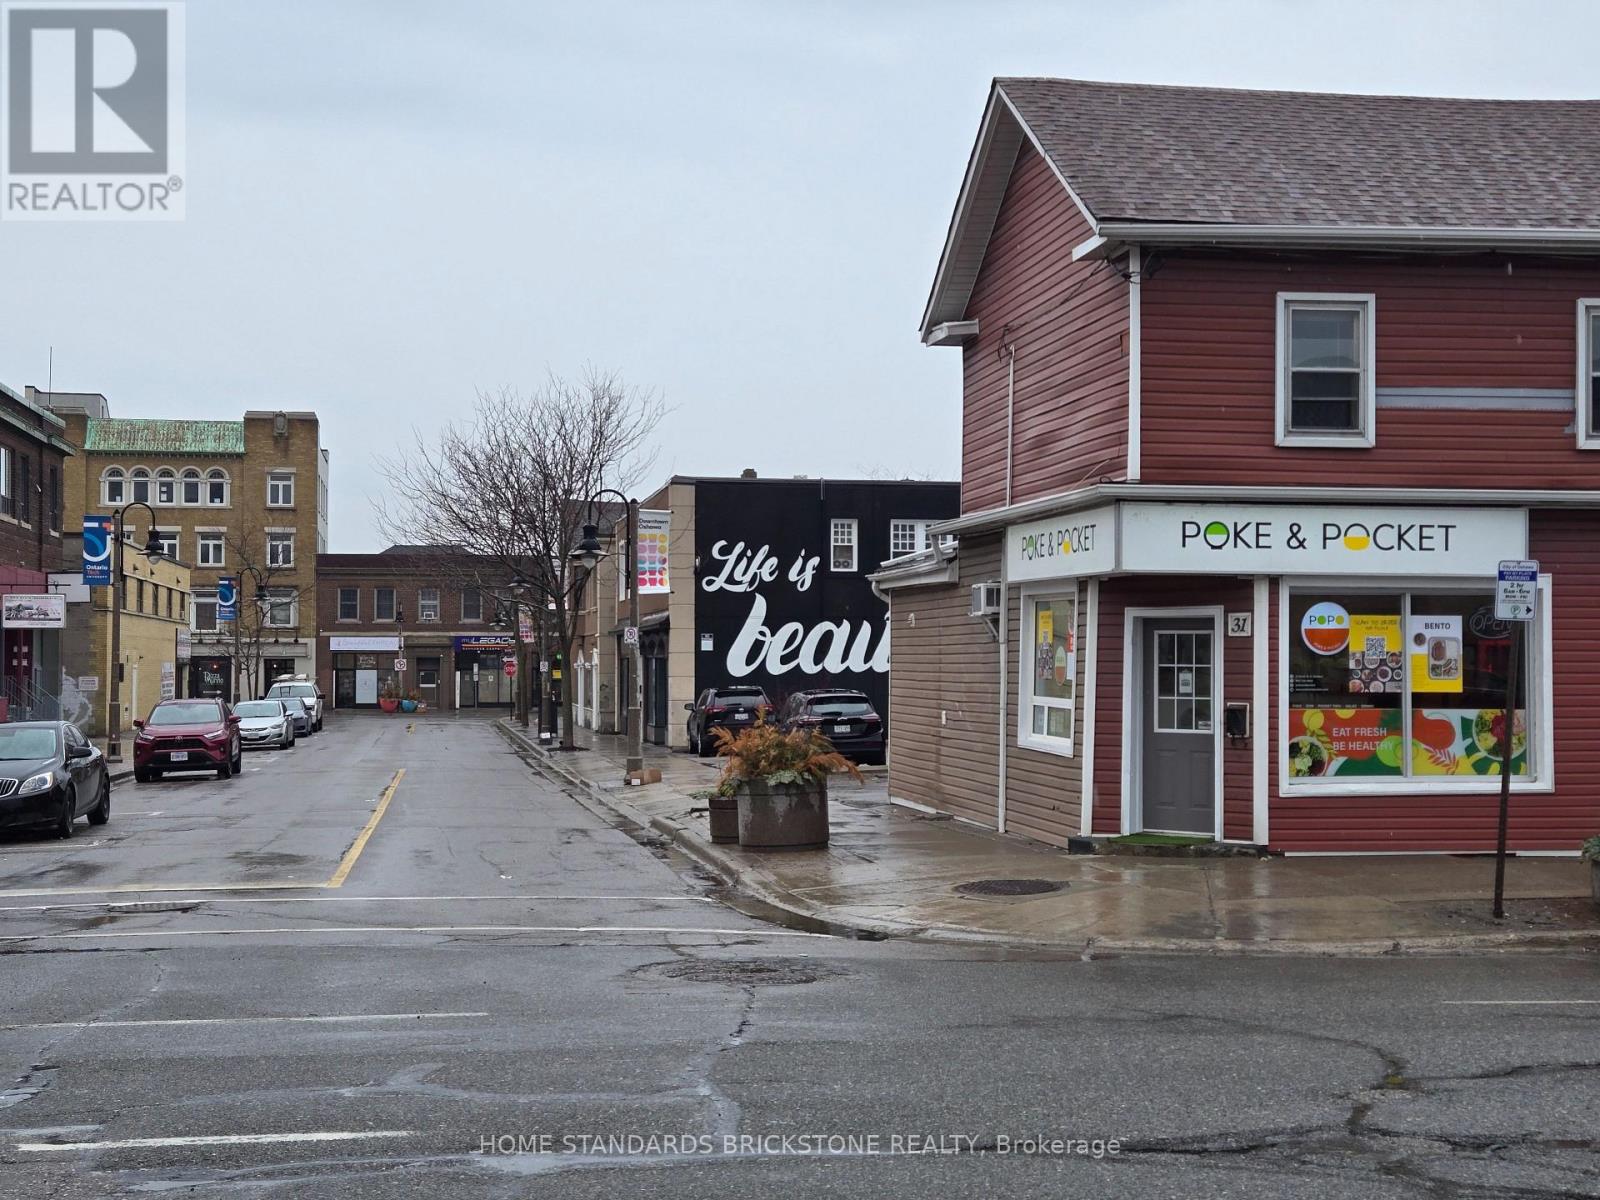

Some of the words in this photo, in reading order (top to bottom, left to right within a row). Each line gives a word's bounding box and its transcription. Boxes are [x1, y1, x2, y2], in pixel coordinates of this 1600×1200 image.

[1022, 533, 1045, 560] POKE
[1048, 531, 1054, 557] &
[1057, 524, 1097, 556] POCKET
[1181, 521, 1272, 550] POKE
[1286, 522, 1308, 550] &
[1322, 522, 1457, 551] POCKET
[701, 540, 779, 593] Life
[788, 548, 821, 592] is
[1231, 617, 1248, 633] 31
[1424, 622, 1451, 630] BENTO
[1333, 727, 1351, 737] EAT
[1354, 727, 1387, 737] FRESH
[1333, 741, 1346, 751] BE
[1349, 741, 1393, 751] HEALTHY
